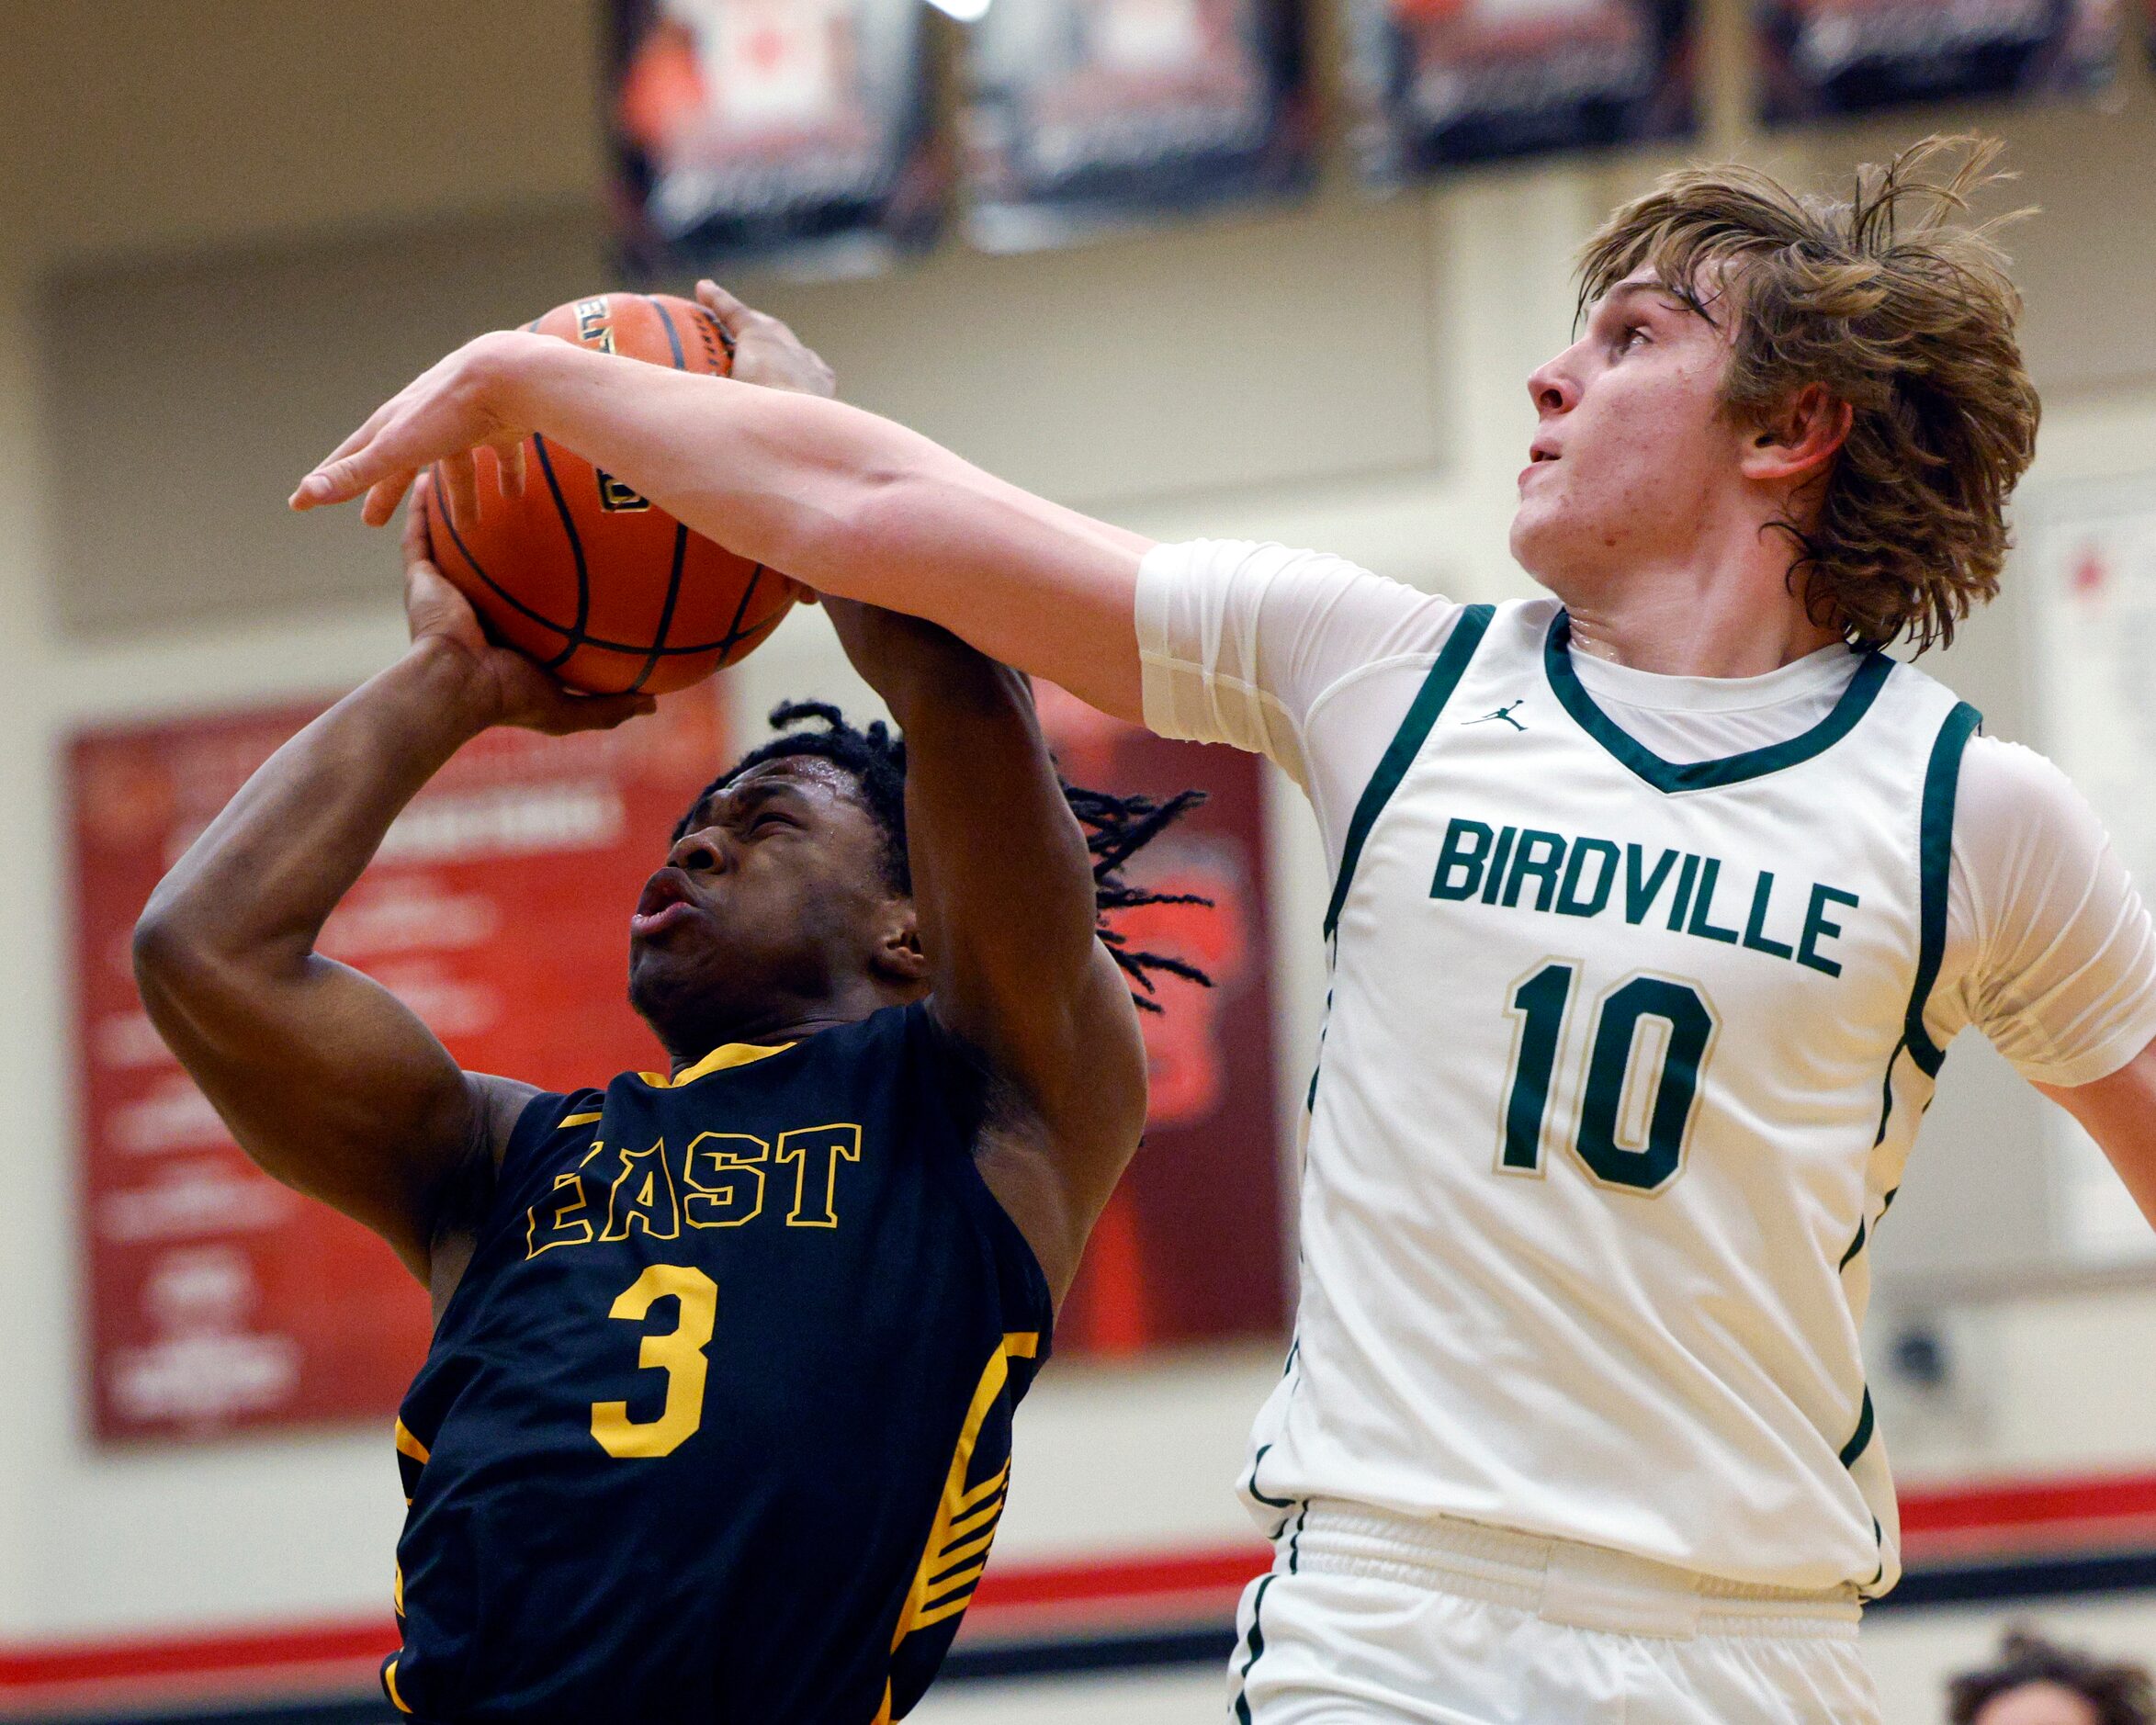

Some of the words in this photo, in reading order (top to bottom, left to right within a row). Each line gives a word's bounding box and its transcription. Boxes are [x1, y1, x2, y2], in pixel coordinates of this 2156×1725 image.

[1429, 817, 1860, 979] BIRDVILLE
[1492, 953, 1723, 1200] 10
[525, 1122, 863, 1261] EAST
[590, 1263, 719, 1459] 3
